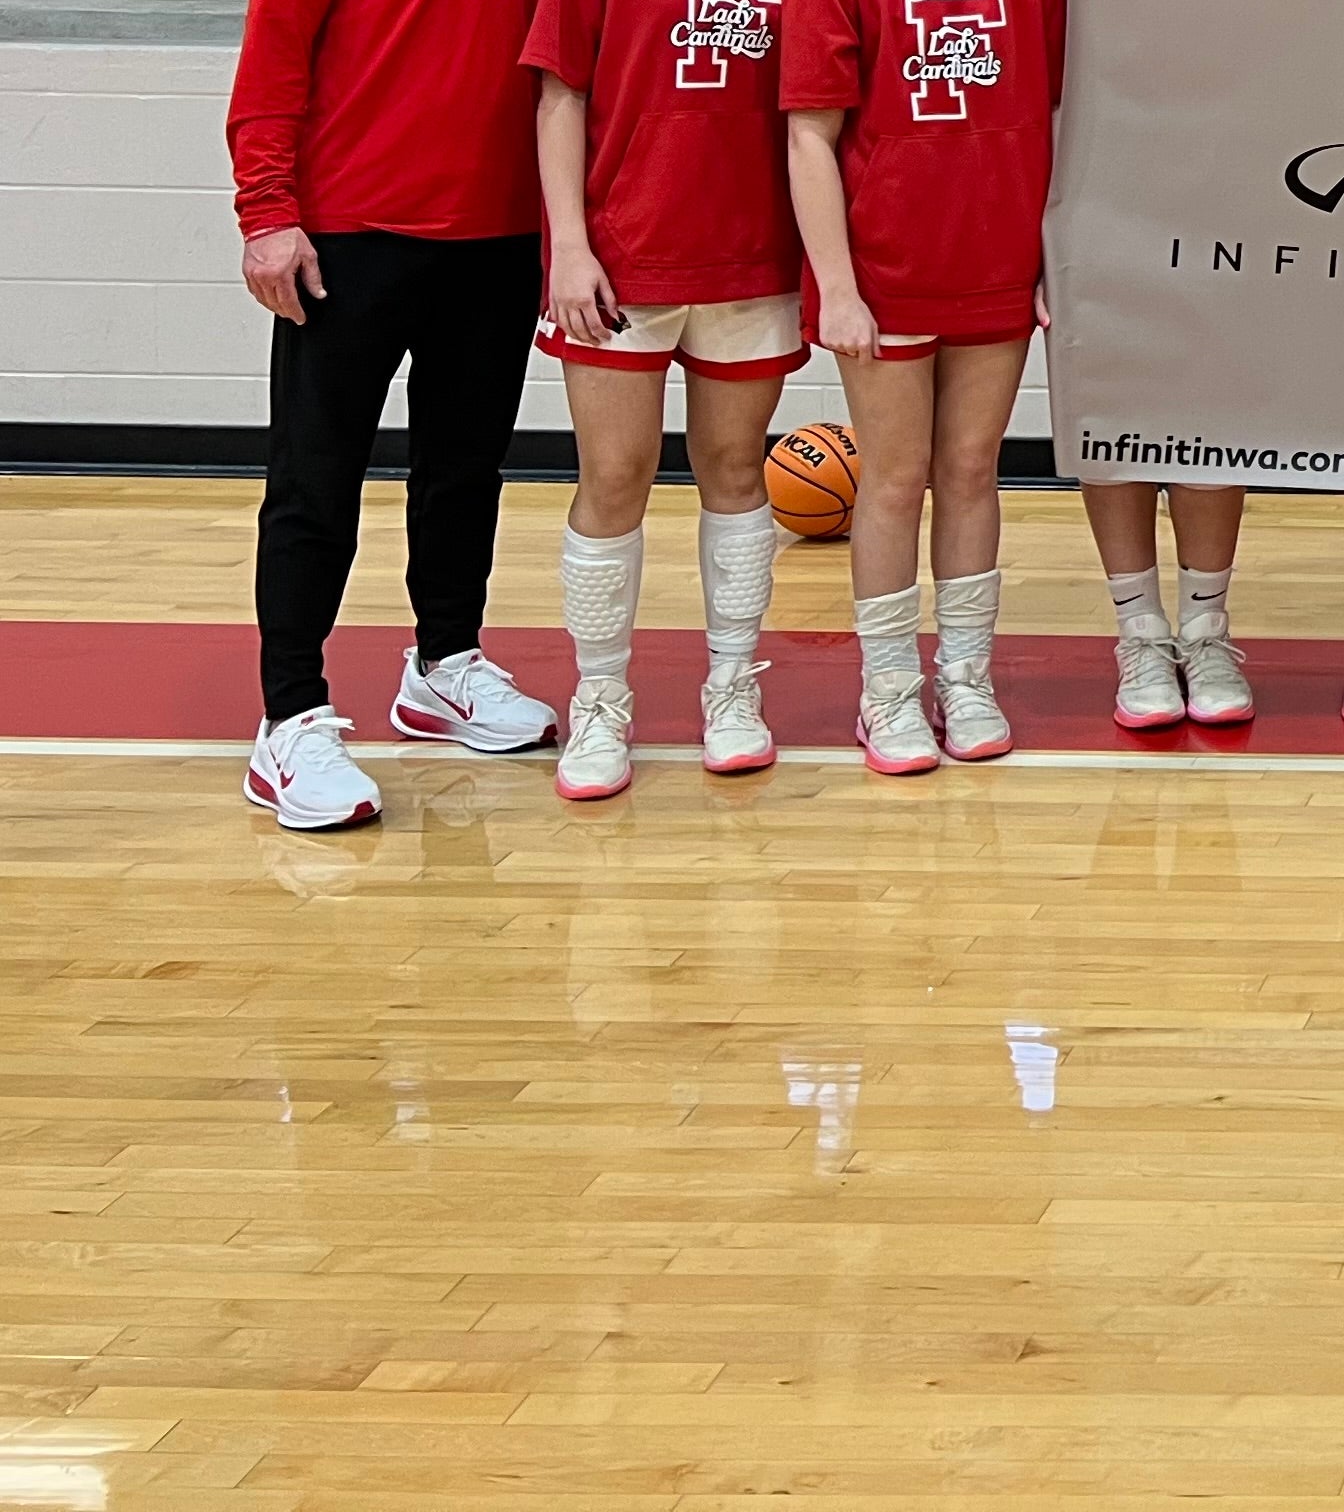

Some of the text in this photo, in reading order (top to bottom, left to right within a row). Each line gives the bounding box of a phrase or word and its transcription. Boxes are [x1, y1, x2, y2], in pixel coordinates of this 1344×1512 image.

[670, 20, 773, 60] Cardinals
[927, 26, 979, 58] Lady
[903, 51, 1003, 87] Cardinals
[781, 434, 826, 468] NCAA
